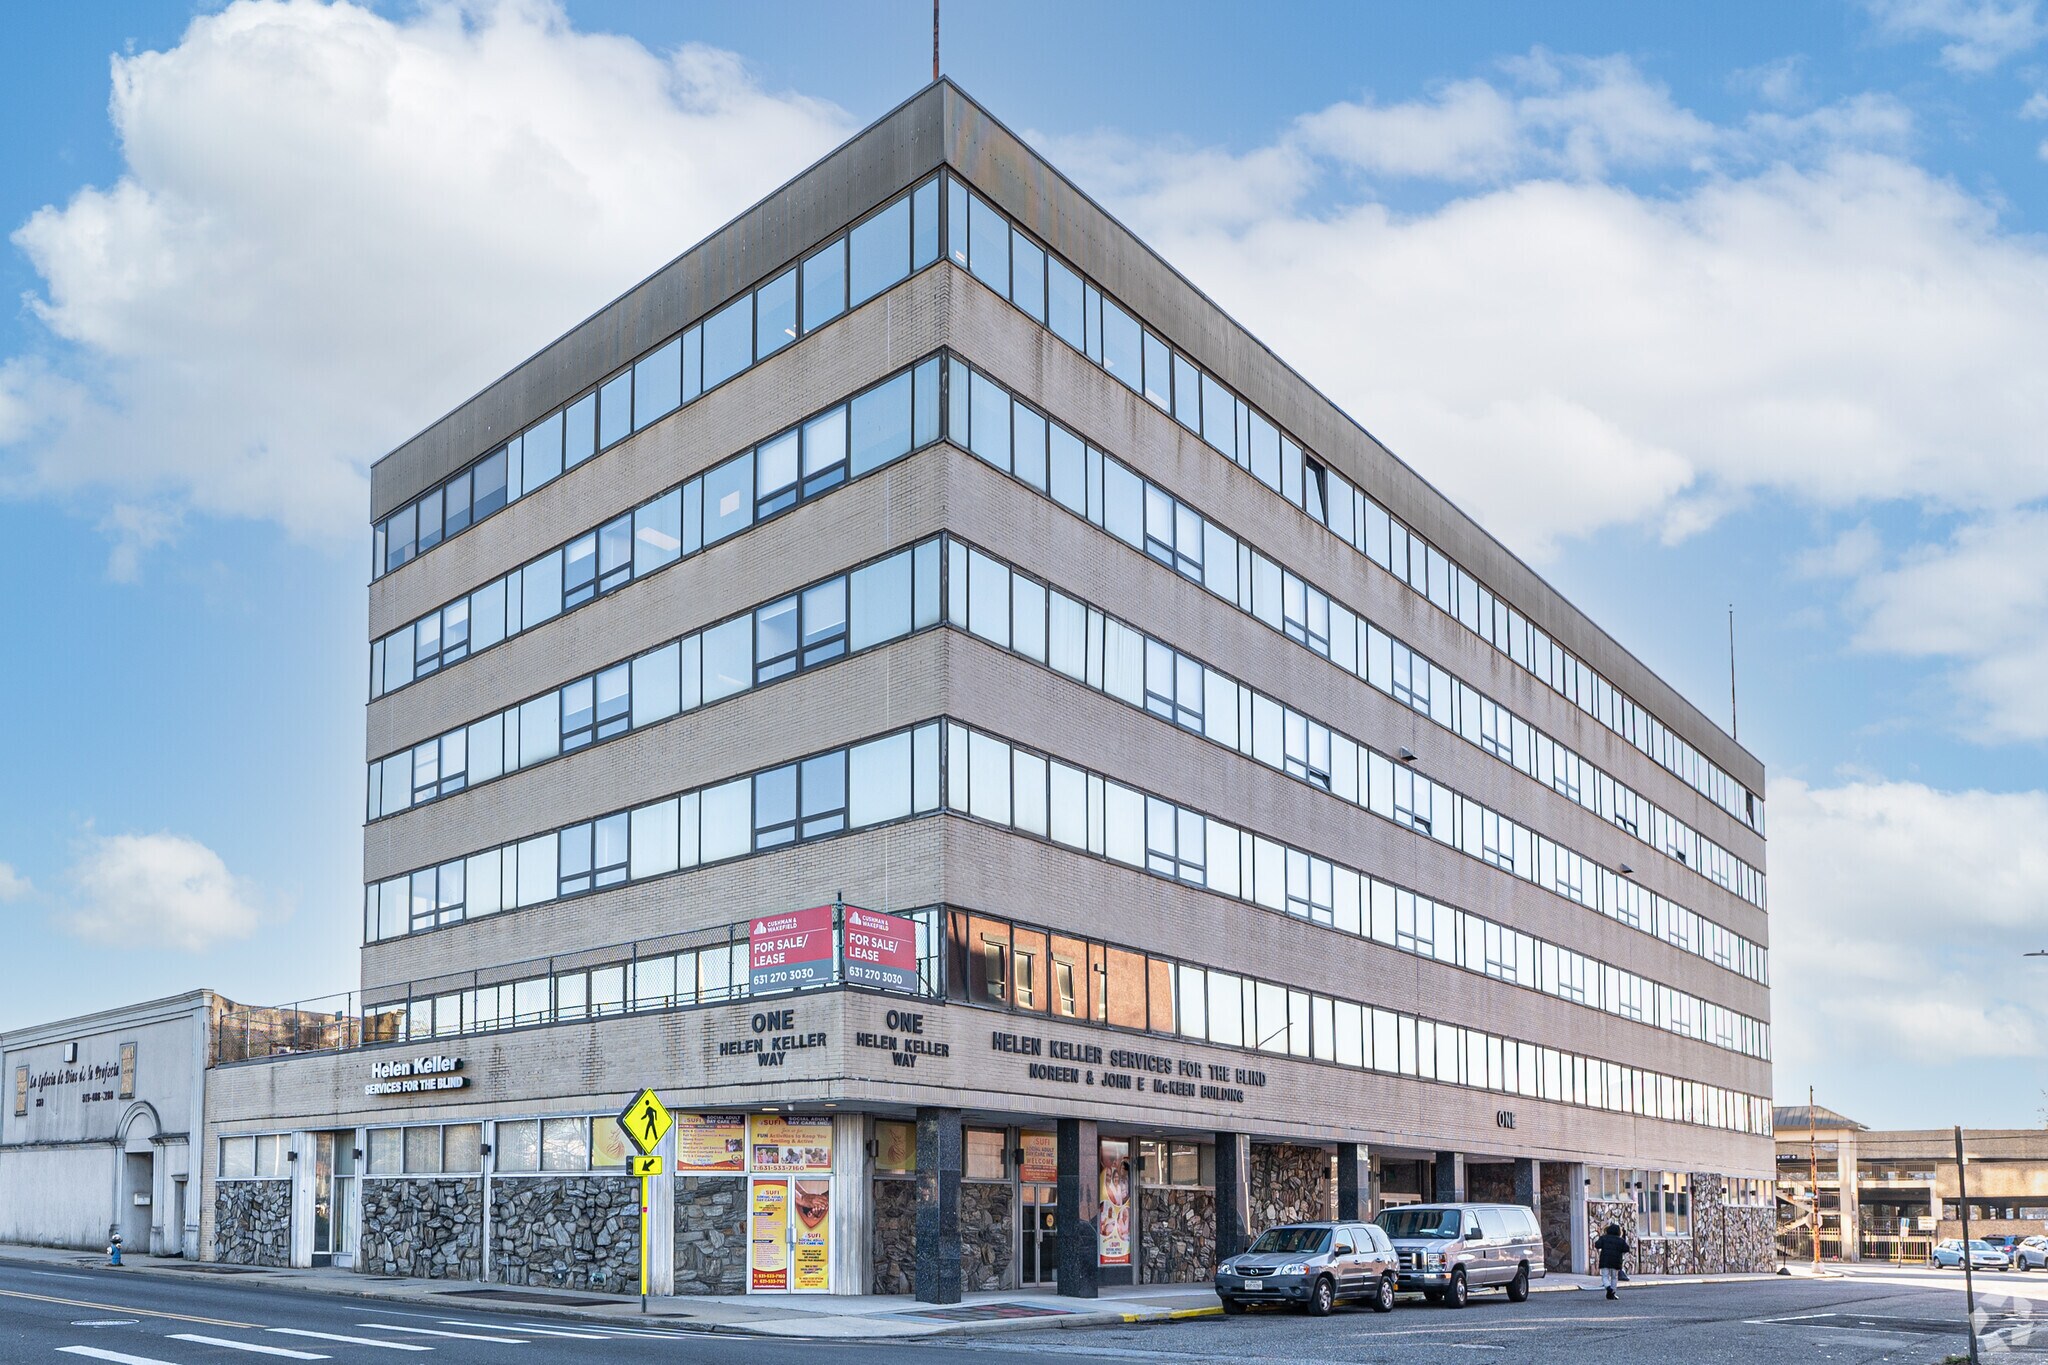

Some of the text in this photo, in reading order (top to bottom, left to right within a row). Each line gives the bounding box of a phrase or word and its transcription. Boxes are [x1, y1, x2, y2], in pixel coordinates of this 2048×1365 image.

[767, 918, 793, 928] CUSHMAN
[767, 923, 798, 933] WAKEFIELD
[862, 915, 885, 925] CUSHMAN
[862, 921, 889, 932] WAKEFIELD
[754, 933, 809, 954] FOR SALE/
[849, 932, 899, 954] FOR SALE/
[754, 952, 785, 967] LEASE
[849, 946, 879, 962] LEASE
[753, 974, 768, 985] 631
[770, 971, 787, 984] 270
[789, 968, 814, 980] 3030
[849, 966, 903, 984] 631 270 3030
[751, 1009, 794, 1034] ONE
[886, 1009, 924, 1034] ONE
[719, 1032, 827, 1056] HELEN KELLER
[856, 1032, 950, 1058] HELEN KELLER
[371, 1055, 459, 1078] Helen Keller
[757, 1052, 786, 1066] WAY
[892, 1052, 918, 1068] WAY
[992, 1031, 1267, 1087] HELEN KELLER SERVICES FOR THE BLIND
[29, 1075, 36, 1088] La
[38, 1071, 56, 1092] Iglesia
[57, 1069, 64, 1086] de
[64, 1068, 78, 1084] Dios
[364, 1076, 464, 1096] SERVICES FOR THE BLIND
[1029, 1062, 1245, 1103] NOREEN & JOHN E McKEEN BUILDING
[1496, 1110, 1516, 1130] ONE
[1036, 1138, 1050, 1146] SUFI
